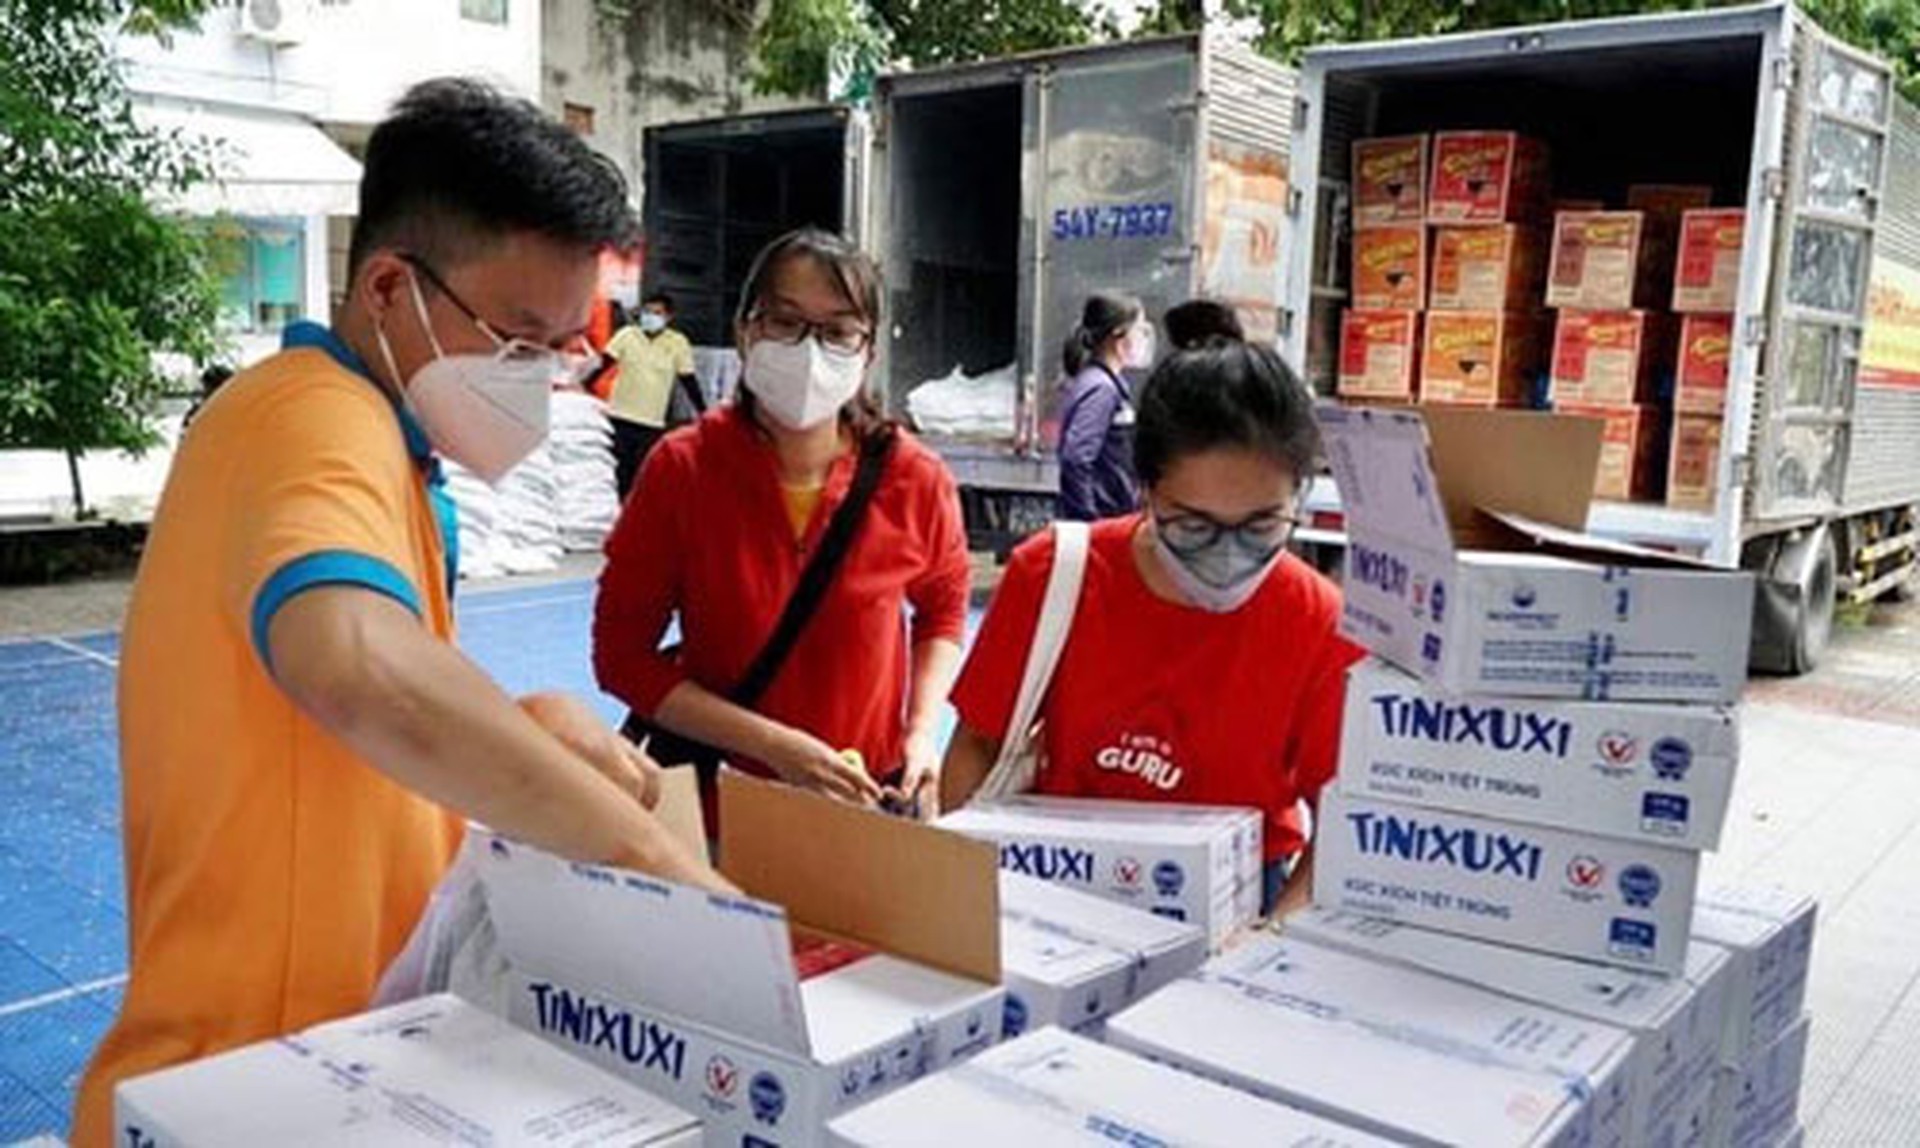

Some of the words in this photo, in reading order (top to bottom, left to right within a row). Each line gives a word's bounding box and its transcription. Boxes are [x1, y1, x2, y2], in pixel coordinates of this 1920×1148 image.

[1370, 693, 1573, 759] TINIXUXI
[1097, 746, 1183, 791] GURU
[1000, 843, 1095, 882] IXUXI
[1346, 812, 1543, 882] TINIXUXI
[527, 982, 687, 1080] TINIXUXI
